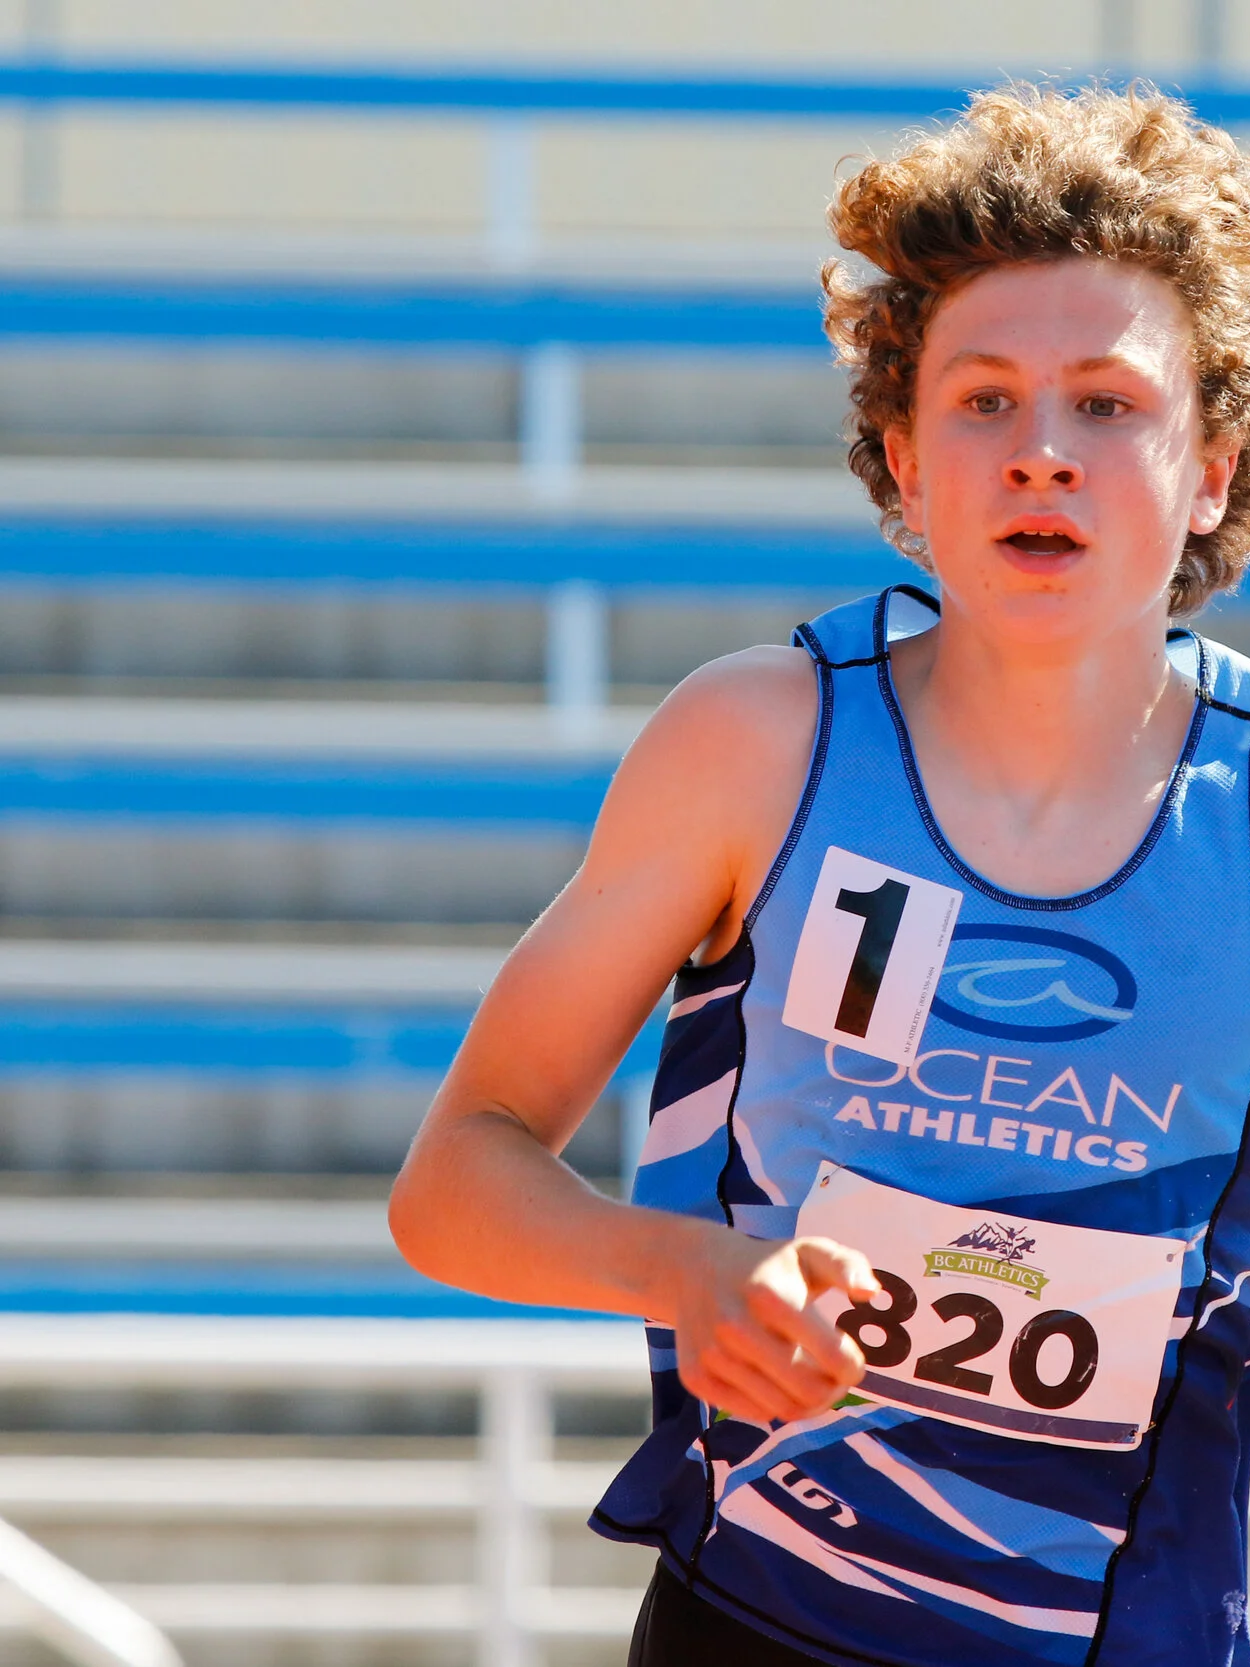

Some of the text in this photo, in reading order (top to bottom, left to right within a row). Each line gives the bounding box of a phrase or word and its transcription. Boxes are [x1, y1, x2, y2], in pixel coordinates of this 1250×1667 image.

[834, 878, 911, 1039] 1
[907, 1008, 922, 1040] ATHLETIC
[833, 1096, 1149, 1173] ATHLETICS
[933, 1253, 956, 1272] BC
[959, 1254, 1041, 1290] ATHLETICS
[834, 1269, 1100, 1410] 820
